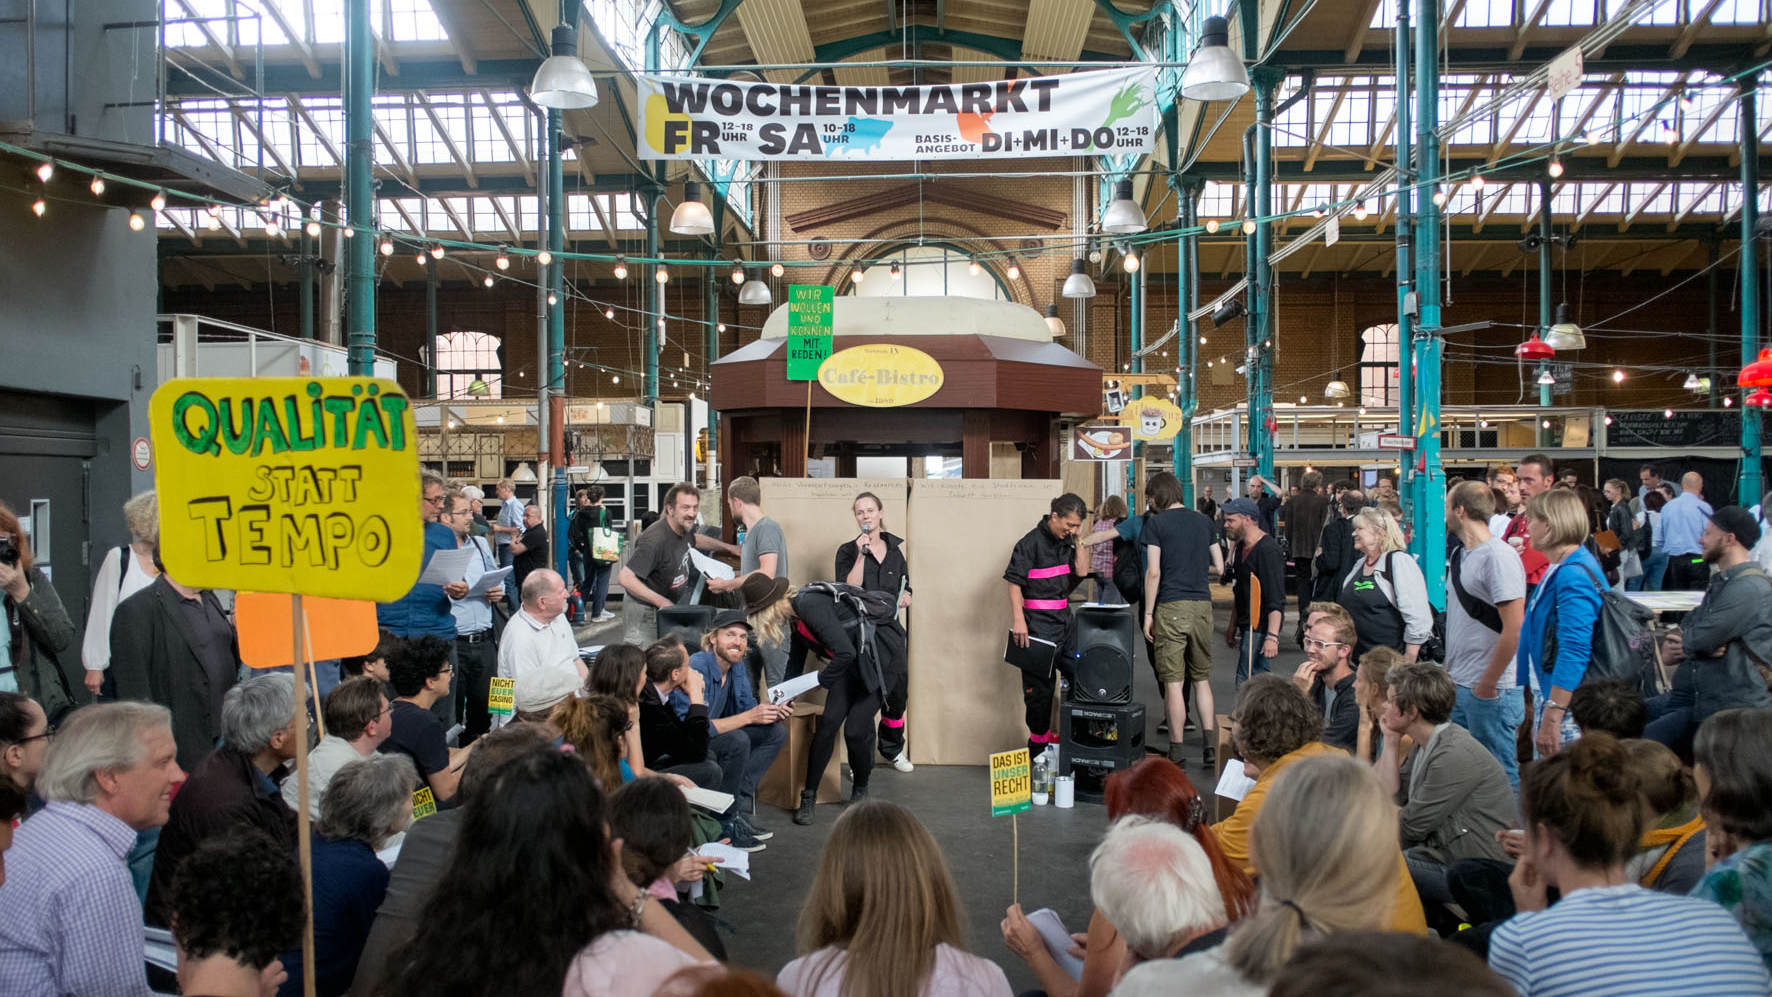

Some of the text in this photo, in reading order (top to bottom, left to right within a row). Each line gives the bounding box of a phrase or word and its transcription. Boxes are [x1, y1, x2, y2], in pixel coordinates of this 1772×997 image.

[1576, 51, 1583, 80] 5
[661, 78, 1060, 117] WOCHENMARKT
[664, 120, 721, 154] FR
[722, 132, 747, 142] UHR
[758, 122, 823, 155] SA
[823, 134, 849, 144] UHR
[915, 134, 957, 143] BASIS-
[1116, 137, 1144, 147] UHR
[915, 143, 975, 154] ANGEBOT
[796, 289, 822, 301] WIR
[790, 302, 831, 314] WOLLEN
[801, 315, 821, 324] UND
[792, 349, 827, 360] REDEN!
[823, 367, 940, 386] Café-Bistro
[248, 465, 362, 507] STATT
[187, 495, 391, 571] TEMPO
[492, 678, 515, 688] NICHT
[491, 688, 513, 697] EUER
[490, 695, 513, 704] CASINO
[993, 751, 1028, 769] DAS IST
[993, 764, 1028, 780] UNSER
[994, 775, 1028, 796] RECHT
